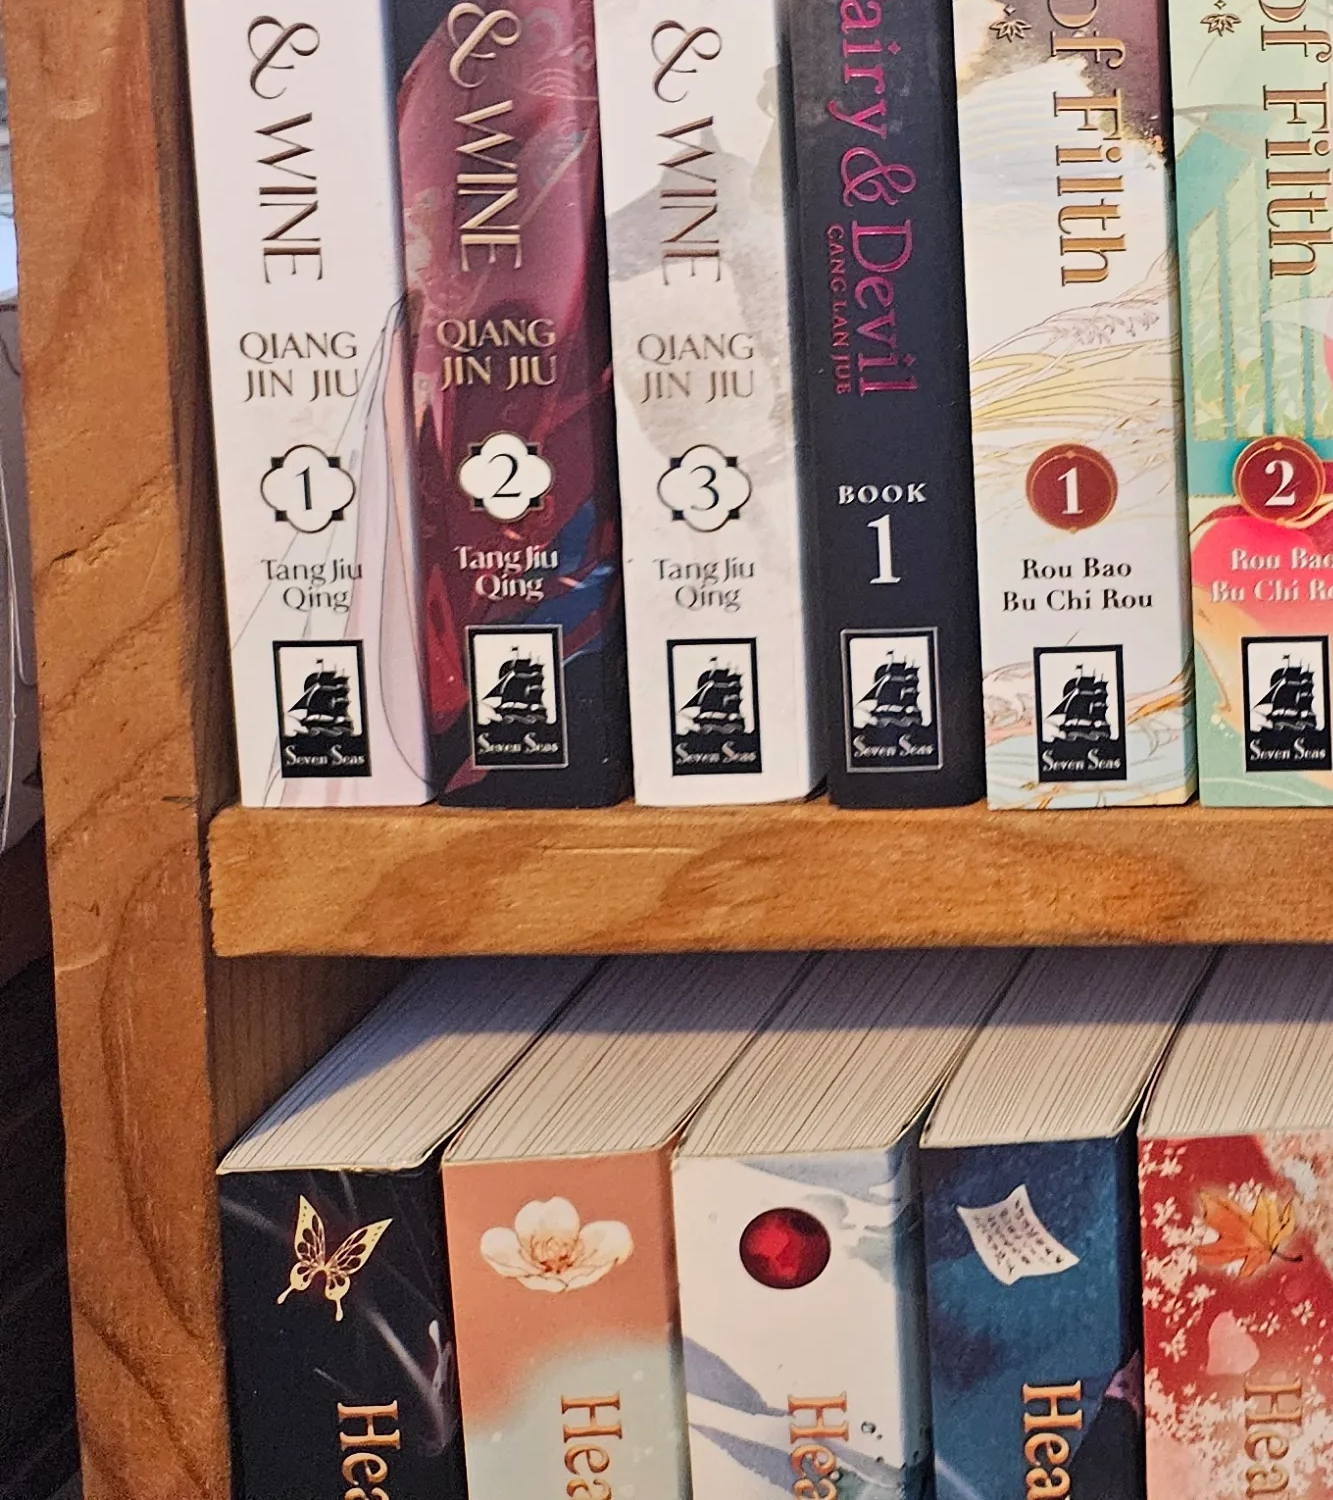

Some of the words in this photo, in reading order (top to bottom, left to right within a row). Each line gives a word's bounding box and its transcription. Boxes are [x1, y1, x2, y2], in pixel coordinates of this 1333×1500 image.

[247, 15, 320, 99] &
[447, 2, 521, 89] &
[652, 20, 722, 103] &
[255, 112, 323, 285] WINE
[454, 99, 522, 273] WINE
[657, 115, 721, 287] WINE
[844, 147, 917, 208] &
[1053, 89, 1126, 286] Filth
[1263, 81, 1333, 280] Filth
[827, 224, 847, 292] CANG
[832, 300, 849, 346] LAN
[850, 219, 919, 398] Devil
[240, 332, 357, 363] QIANG
[245, 369, 293, 402] JIN
[311, 369, 359, 401] JIU
[831, 354, 851, 395] JUE
[296, 468, 313, 511] 1
[487, 454, 522, 500] 2
[689, 466, 720, 511] 3
[838, 483, 928, 505] BOOK
[1057, 467, 1083, 516] 1
[1264, 460, 1296, 507] 2
[867, 514, 901, 586] 1
[1022, 559, 1072, 580] Rou
[1083, 557, 1132, 578] Bao
[1003, 591, 1036, 613] Bu
[1046, 589, 1091, 610] Chi
[1101, 588, 1153, 609] Rou
[286, 745, 328, 767] Seven
[332, 744, 365, 765] Seas
